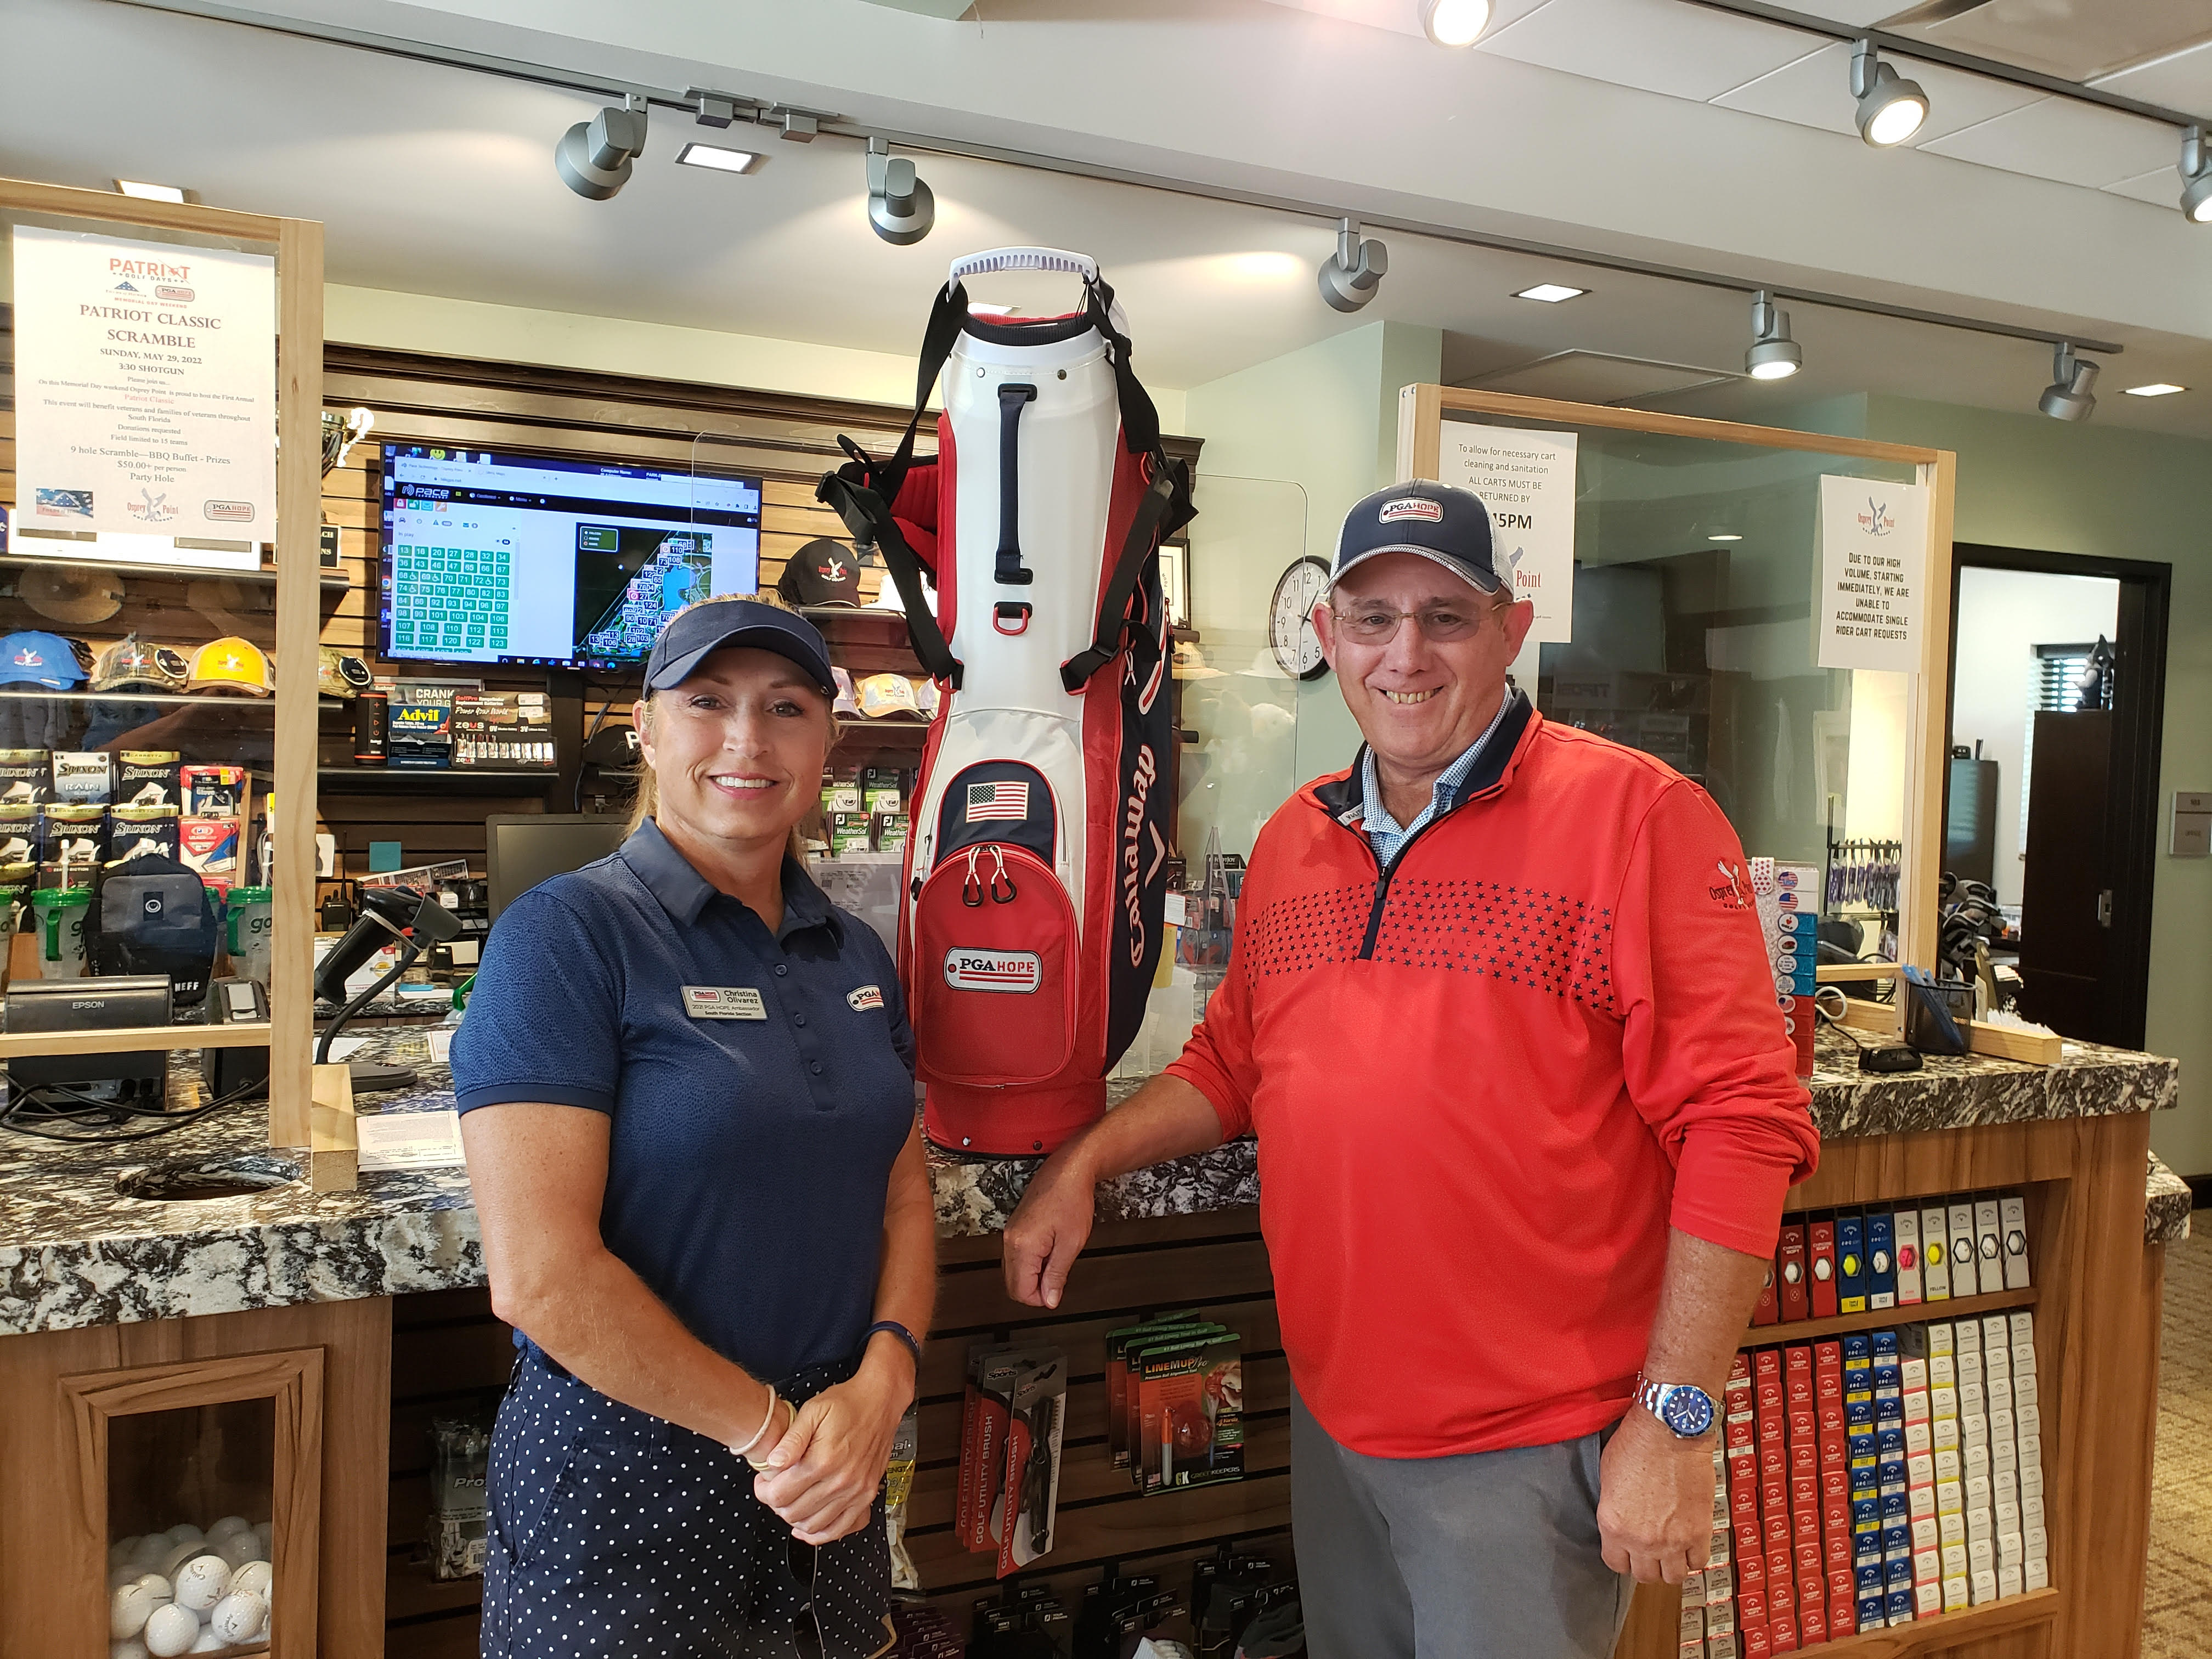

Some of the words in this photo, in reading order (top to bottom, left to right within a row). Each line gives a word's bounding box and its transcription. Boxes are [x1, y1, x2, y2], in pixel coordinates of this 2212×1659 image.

[80, 304, 152, 322] PATRIOT
[157, 313, 221, 329] CLASSIC
[108, 329, 195, 348] SCRAMBLE
[100, 348, 140, 359] SUNDAY,
[139, 365, 184, 375] SHOTGUN
[173, 453, 198, 461] Buffet
[206, 455, 230, 464] Prizes
[1459, 444, 1467, 452] To
[1469, 445, 1488, 455] allow
[1490, 447, 1500, 456] for
[1502, 450, 1539, 461] necessary
[117, 460, 152, 469] $50.00+
[1464, 459, 1493, 471] cleaning
[1511, 465, 1548, 474] sanitation
[130, 472, 152, 482] Party
[1469, 476, 1481, 485] ALL
[1483, 477, 1506, 487] CARTS
[1509, 479, 1531, 489] MUST
[1479, 491, 1519, 502] RETURNED
[1521, 495, 1530, 503] BY
[127, 503, 146, 512] Osprey
[163, 505, 178, 514] Point
[1883, 517, 1895, 528] Point
[1849, 552, 1861, 563] DUE
[1864, 555, 1871, 565] TO
[1873, 557, 1884, 566] OUR
[1887, 557, 1900, 568] HIGH
[1304, 572, 1311, 584] 12
[1318, 575, 1321, 587] 1
[1516, 569, 1541, 588] Point
[1844, 568, 1872, 580] VOLUME,
[1874, 571, 1904, 583] STARTING
[1293, 579, 1299, 592] 11
[1837, 582, 1882, 596] IMMEDIATELY,
[1884, 586, 1894, 596] WE
[1897, 588, 1909, 597] ARE
[1284, 597, 1291, 609] 10
[1856, 598, 1880, 609] UNABLE
[1882, 601, 1889, 610] TO
[1282, 617, 1286, 629] 9
[1836, 611, 1883, 624] ACCOMMODATE
[1886, 615, 1908, 625] SINGLE
[1836, 625, 1854, 636] RIDER
[1856, 627, 1872, 637] CART
[1874, 629, 1907, 640] REQUESTS
[1284, 635, 1288, 647] 8
[1292, 650, 1296, 661] 7
[1302, 652, 1308, 664] 6
[1314, 647, 1320, 658] 5
[415, 689, 454, 699] CRANK
[398, 708, 439, 721] Advil
[475, 707, 489, 715] Your
[57, 763, 108, 778] SRIXON
[122, 766, 170, 781] SRIXON
[65, 783, 100, 791] RAIN
[835, 814, 845, 825] FJ
[883, 815, 893, 827] FJ
[49, 822, 101, 838] SRIXON
[113, 822, 162, 838] SRIXON
[1124, 743, 1155, 969] Callaway
[174, 981, 199, 992] NEFF
[72, 1000, 105, 1009] EPSON
[988, 1369, 1017, 1379] Sports
[1017, 1384, 1036, 1398] Sports
[983, 1416, 992, 1460] BRUSH
[1009, 1435, 1018, 1483] BRUSH
[1191, 1466, 1240, 1479] GREENKEEPERS
[453, 1477, 487, 1489] Pro
[979, 1465, 989, 1509] UTILITY
[1005, 1486, 1014, 1533] UTILITY
[976, 1511, 986, 1544] GOLF
